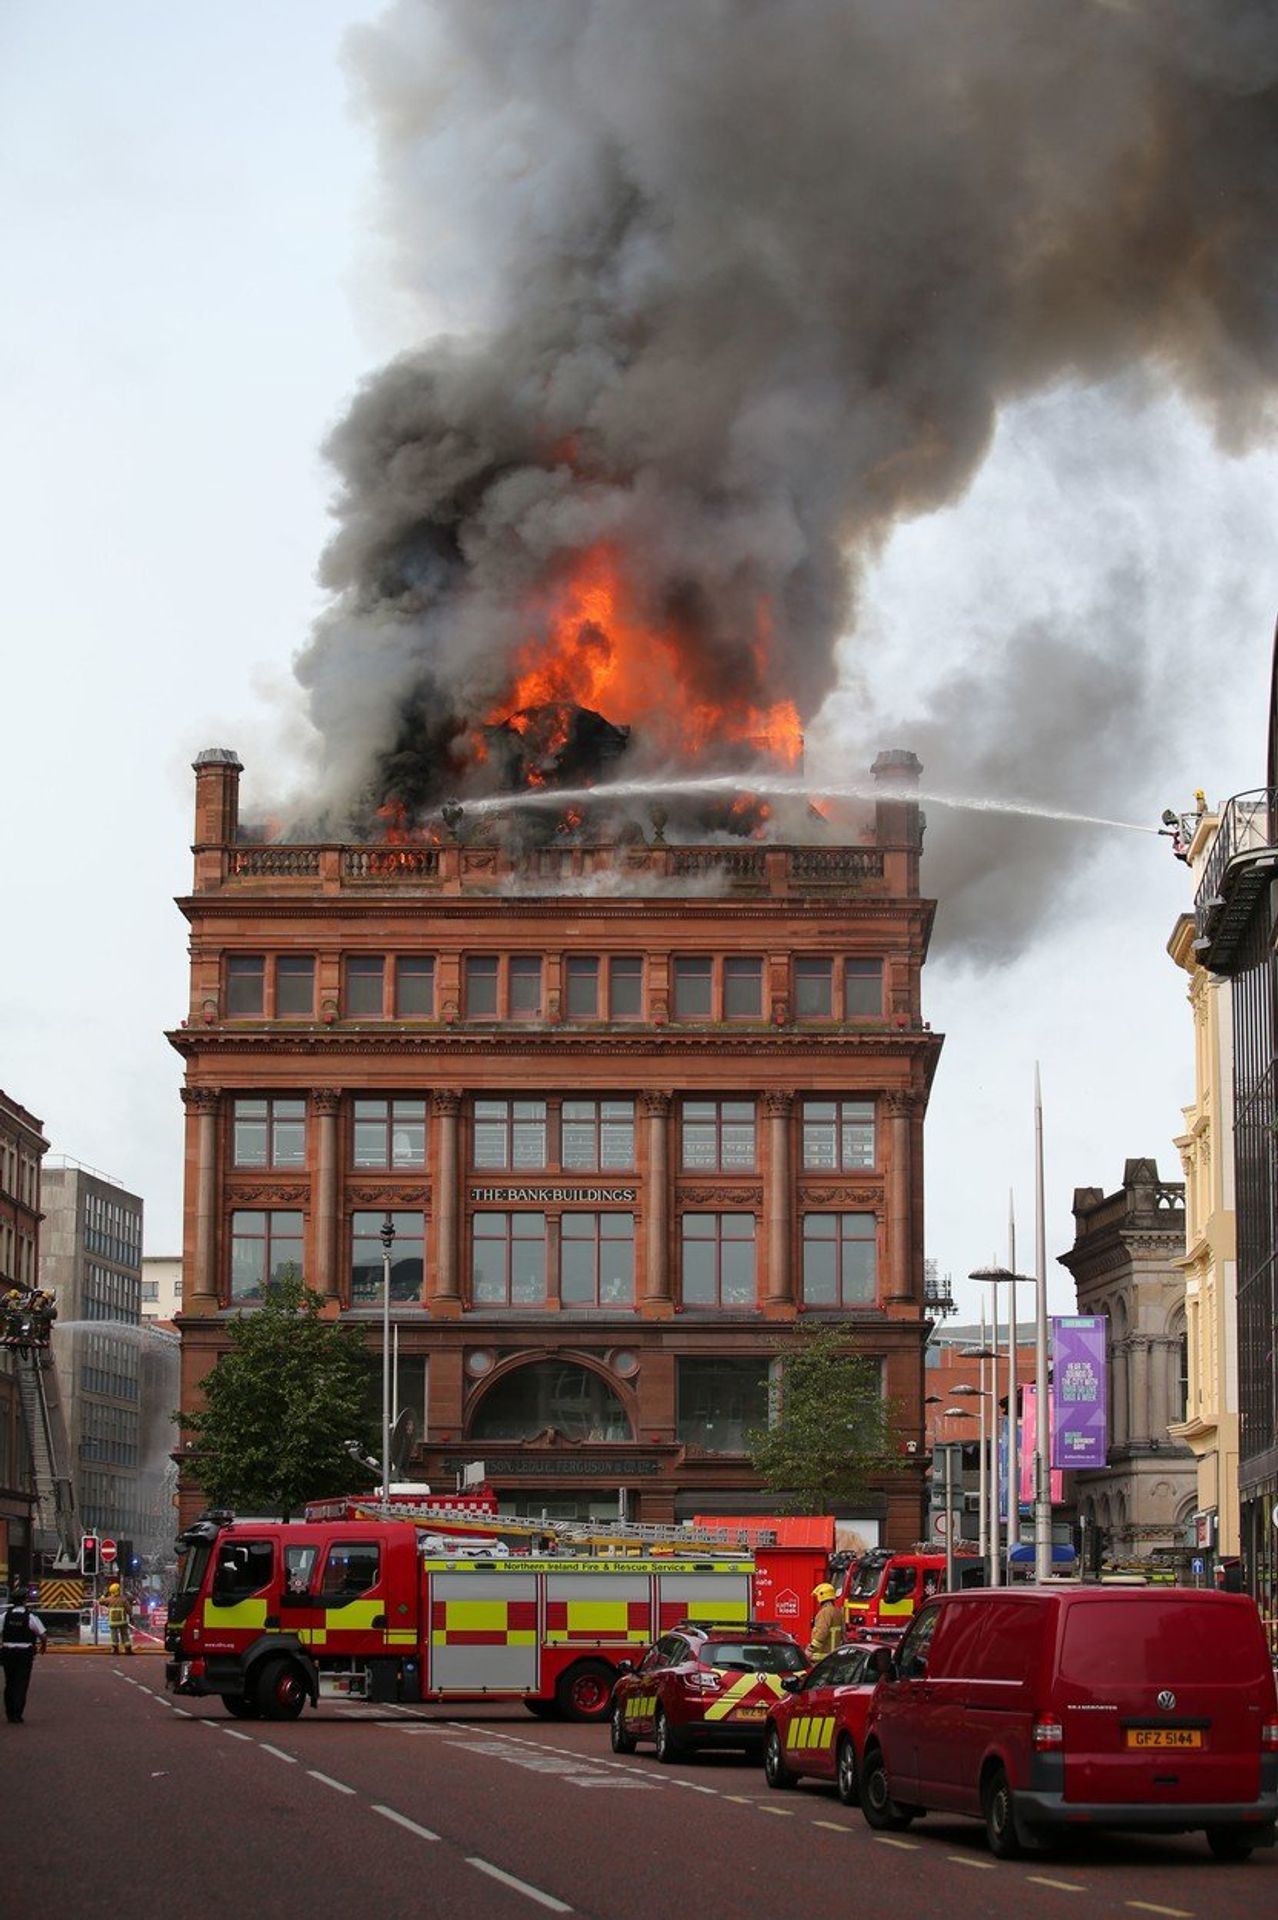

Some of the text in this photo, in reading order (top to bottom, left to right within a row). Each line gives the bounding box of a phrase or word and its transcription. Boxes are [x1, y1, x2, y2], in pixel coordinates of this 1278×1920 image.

[473, 1188, 633, 1201] THE BANK BUILDINGS
[503, 1562, 686, 1571] Northern Ireland Fire & Rescue Service
[1136, 1732, 1193, 1745] GFZ 5144
